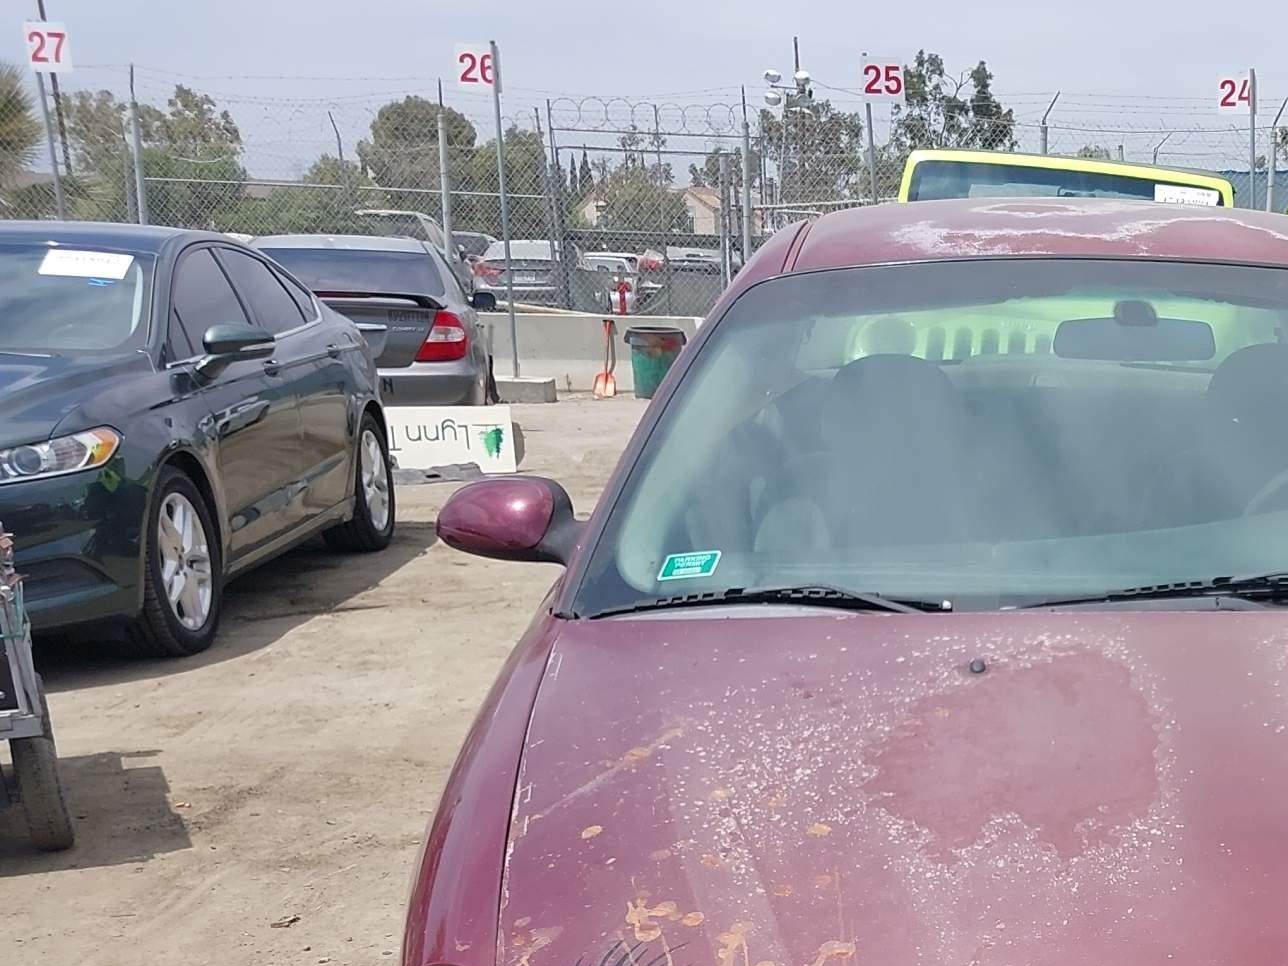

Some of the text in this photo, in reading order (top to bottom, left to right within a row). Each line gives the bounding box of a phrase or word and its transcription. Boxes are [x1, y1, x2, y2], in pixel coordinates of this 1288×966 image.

[28, 31, 66, 63] 27
[459, 53, 493, 84] 26
[863, 64, 902, 95] 25
[1220, 79, 1251, 107] 24
[405, 418, 471, 451] Lynn
